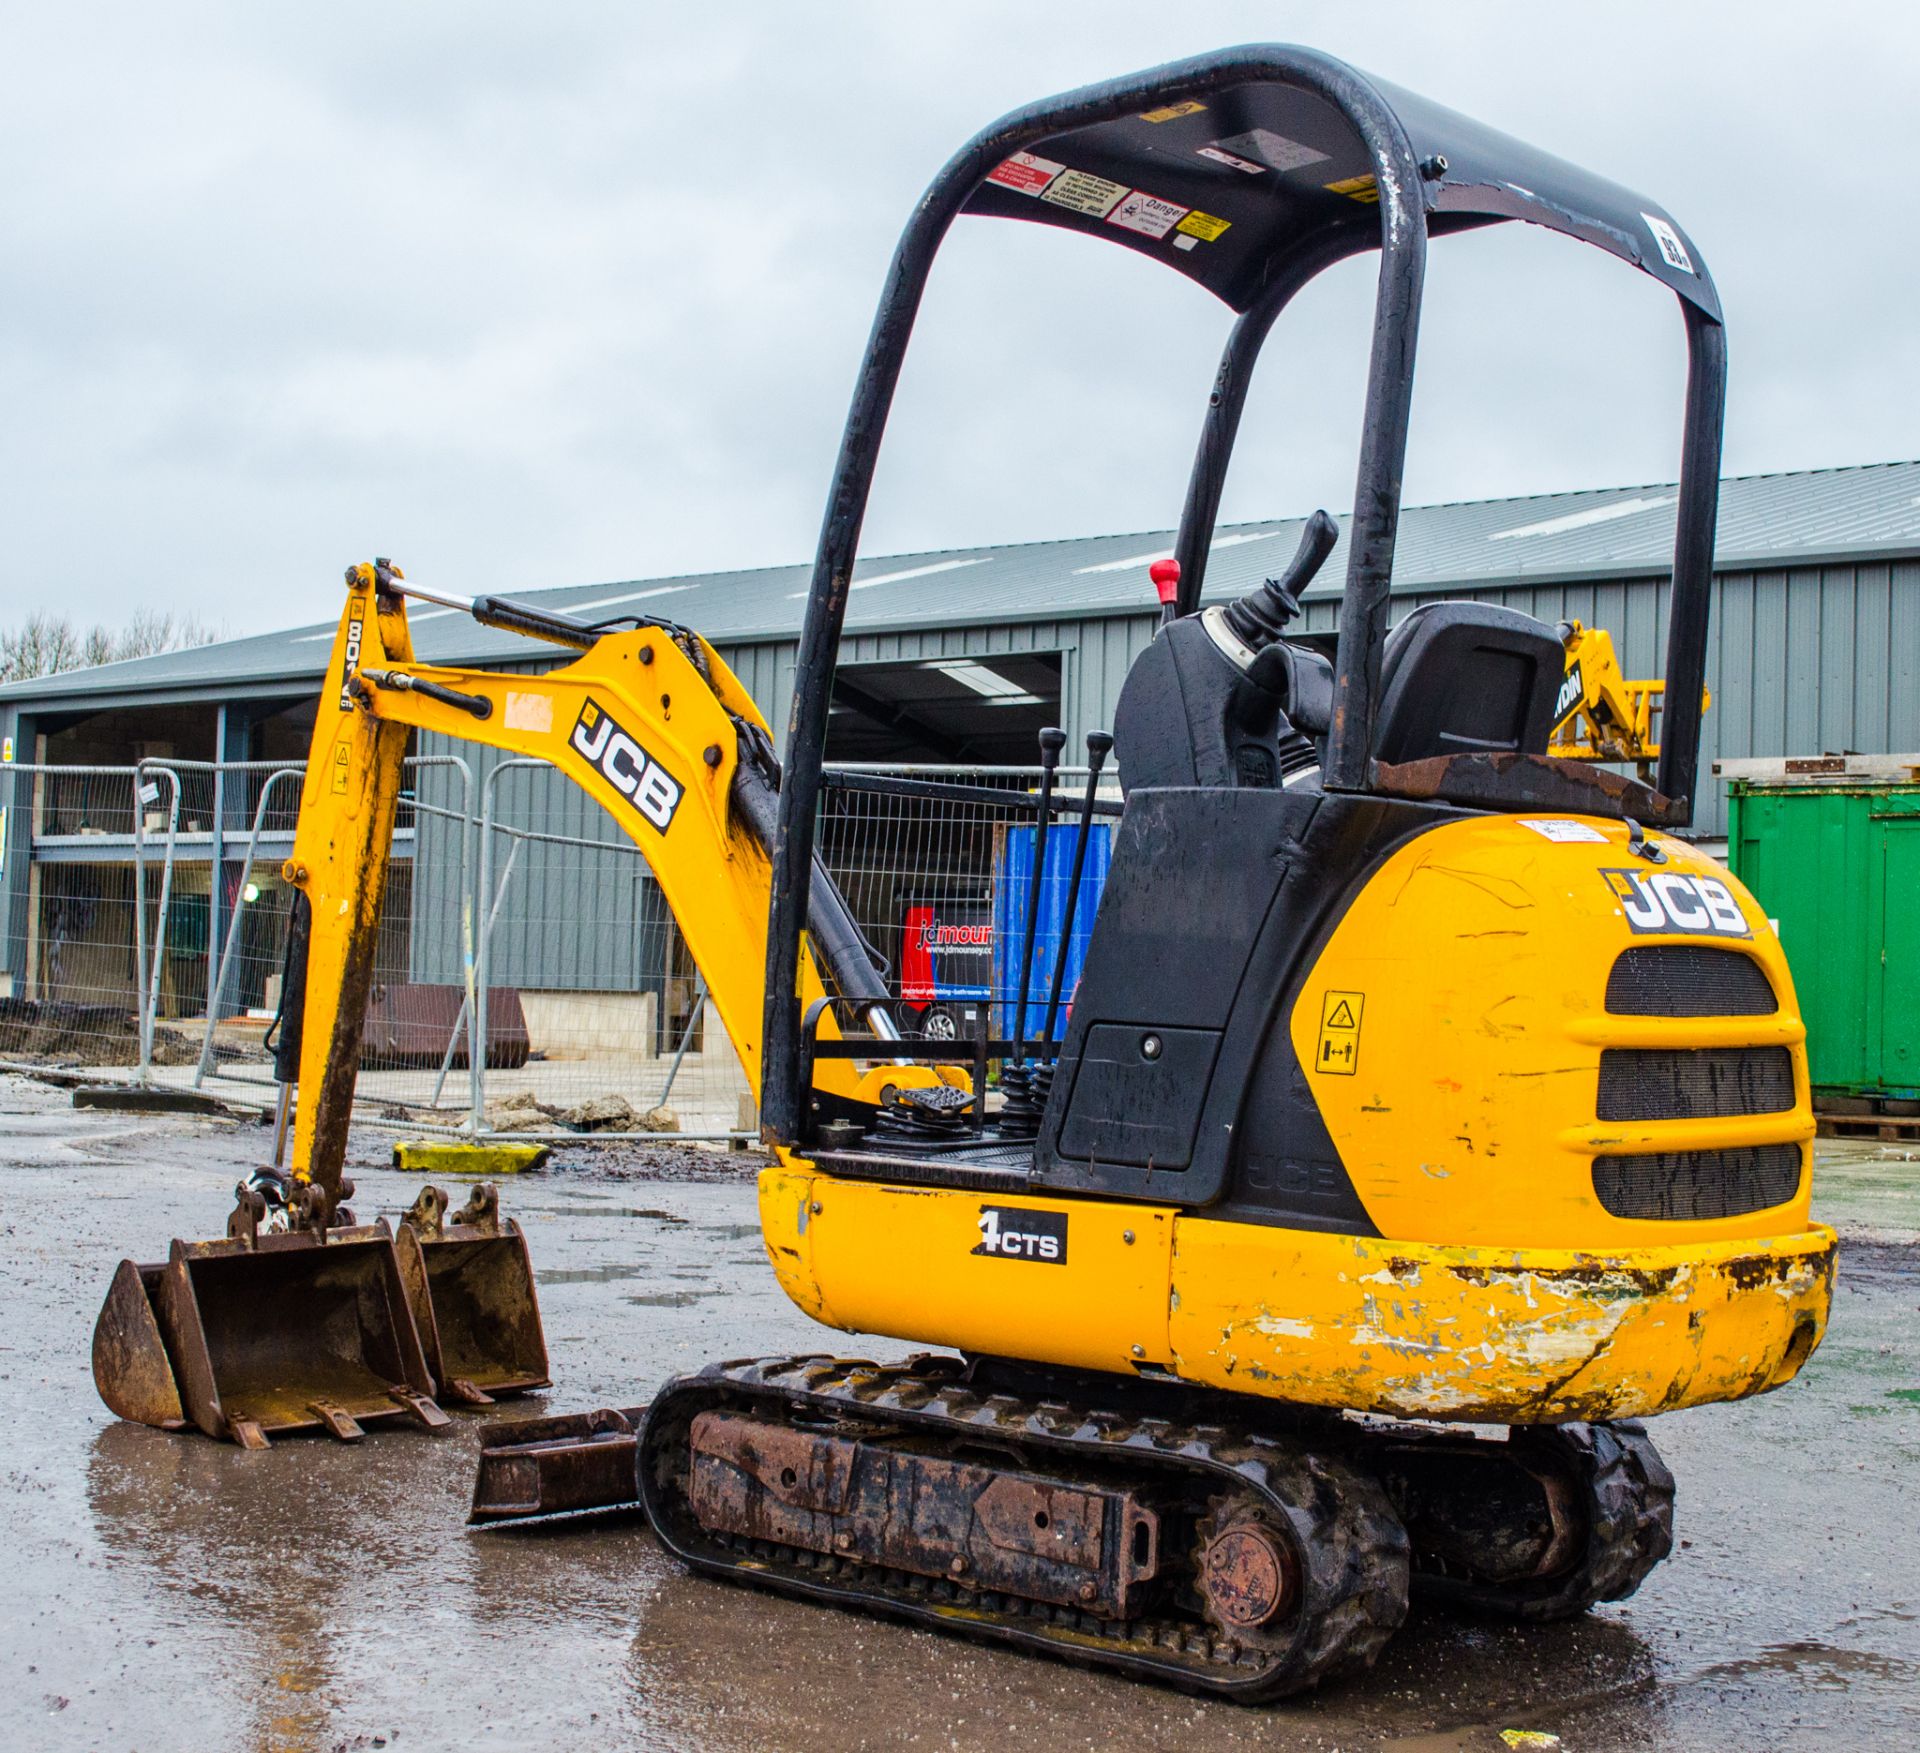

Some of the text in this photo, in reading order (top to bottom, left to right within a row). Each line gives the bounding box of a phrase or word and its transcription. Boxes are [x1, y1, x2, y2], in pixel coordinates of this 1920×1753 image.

[1146, 199, 1185, 217] Danger
[573, 717, 679, 828] JCB
[1623, 872, 1749, 933] JCB
[1001, 1231, 1059, 1258] CTS
